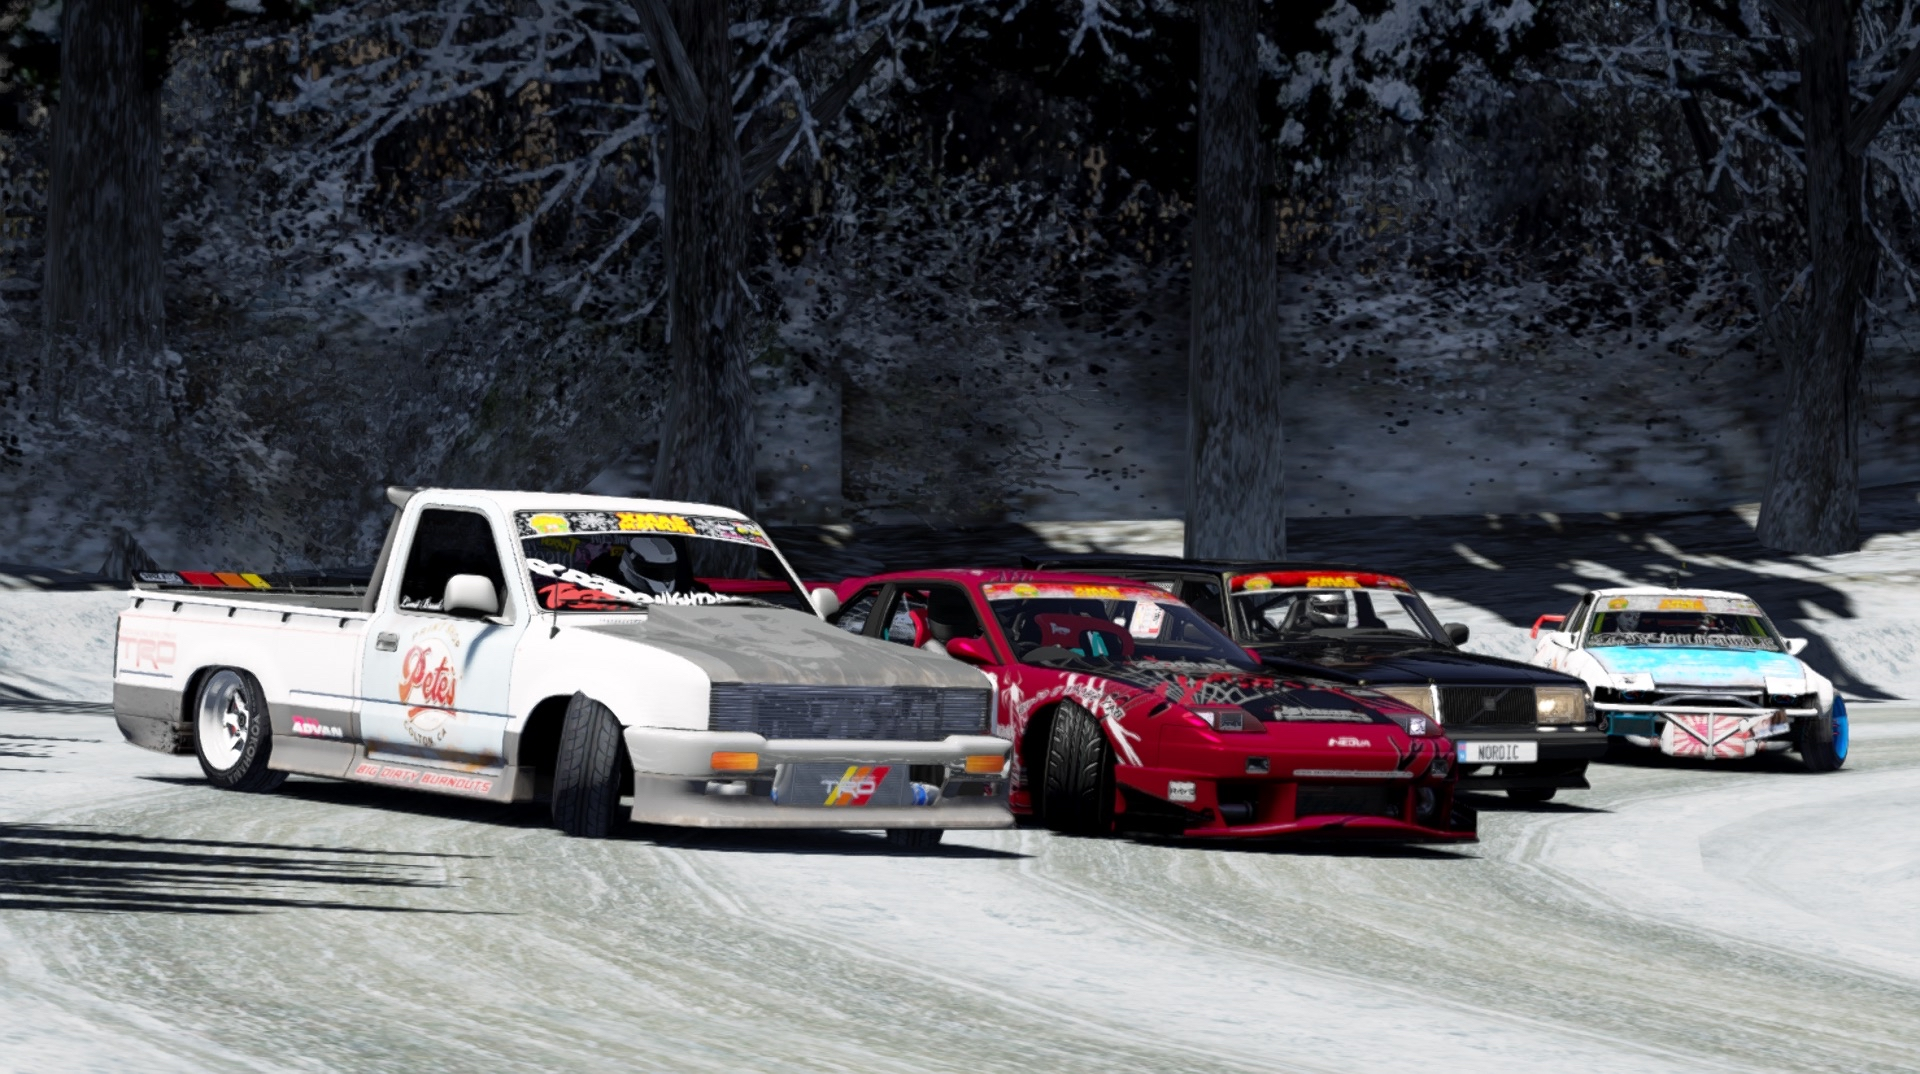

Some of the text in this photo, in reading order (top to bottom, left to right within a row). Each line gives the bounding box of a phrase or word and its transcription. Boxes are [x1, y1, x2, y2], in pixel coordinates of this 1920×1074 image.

[119, 636, 177, 670] TRD
[292, 721, 344, 738] ADVAN
[403, 719, 447, 747] COLTON CA
[217, 713, 260, 784] YOKOHAMA
[1479, 744, 1519, 760] NORDIC
[354, 762, 494, 795] BIG DIRTY BURNOUTS
[821, 780, 876, 799] TRD
